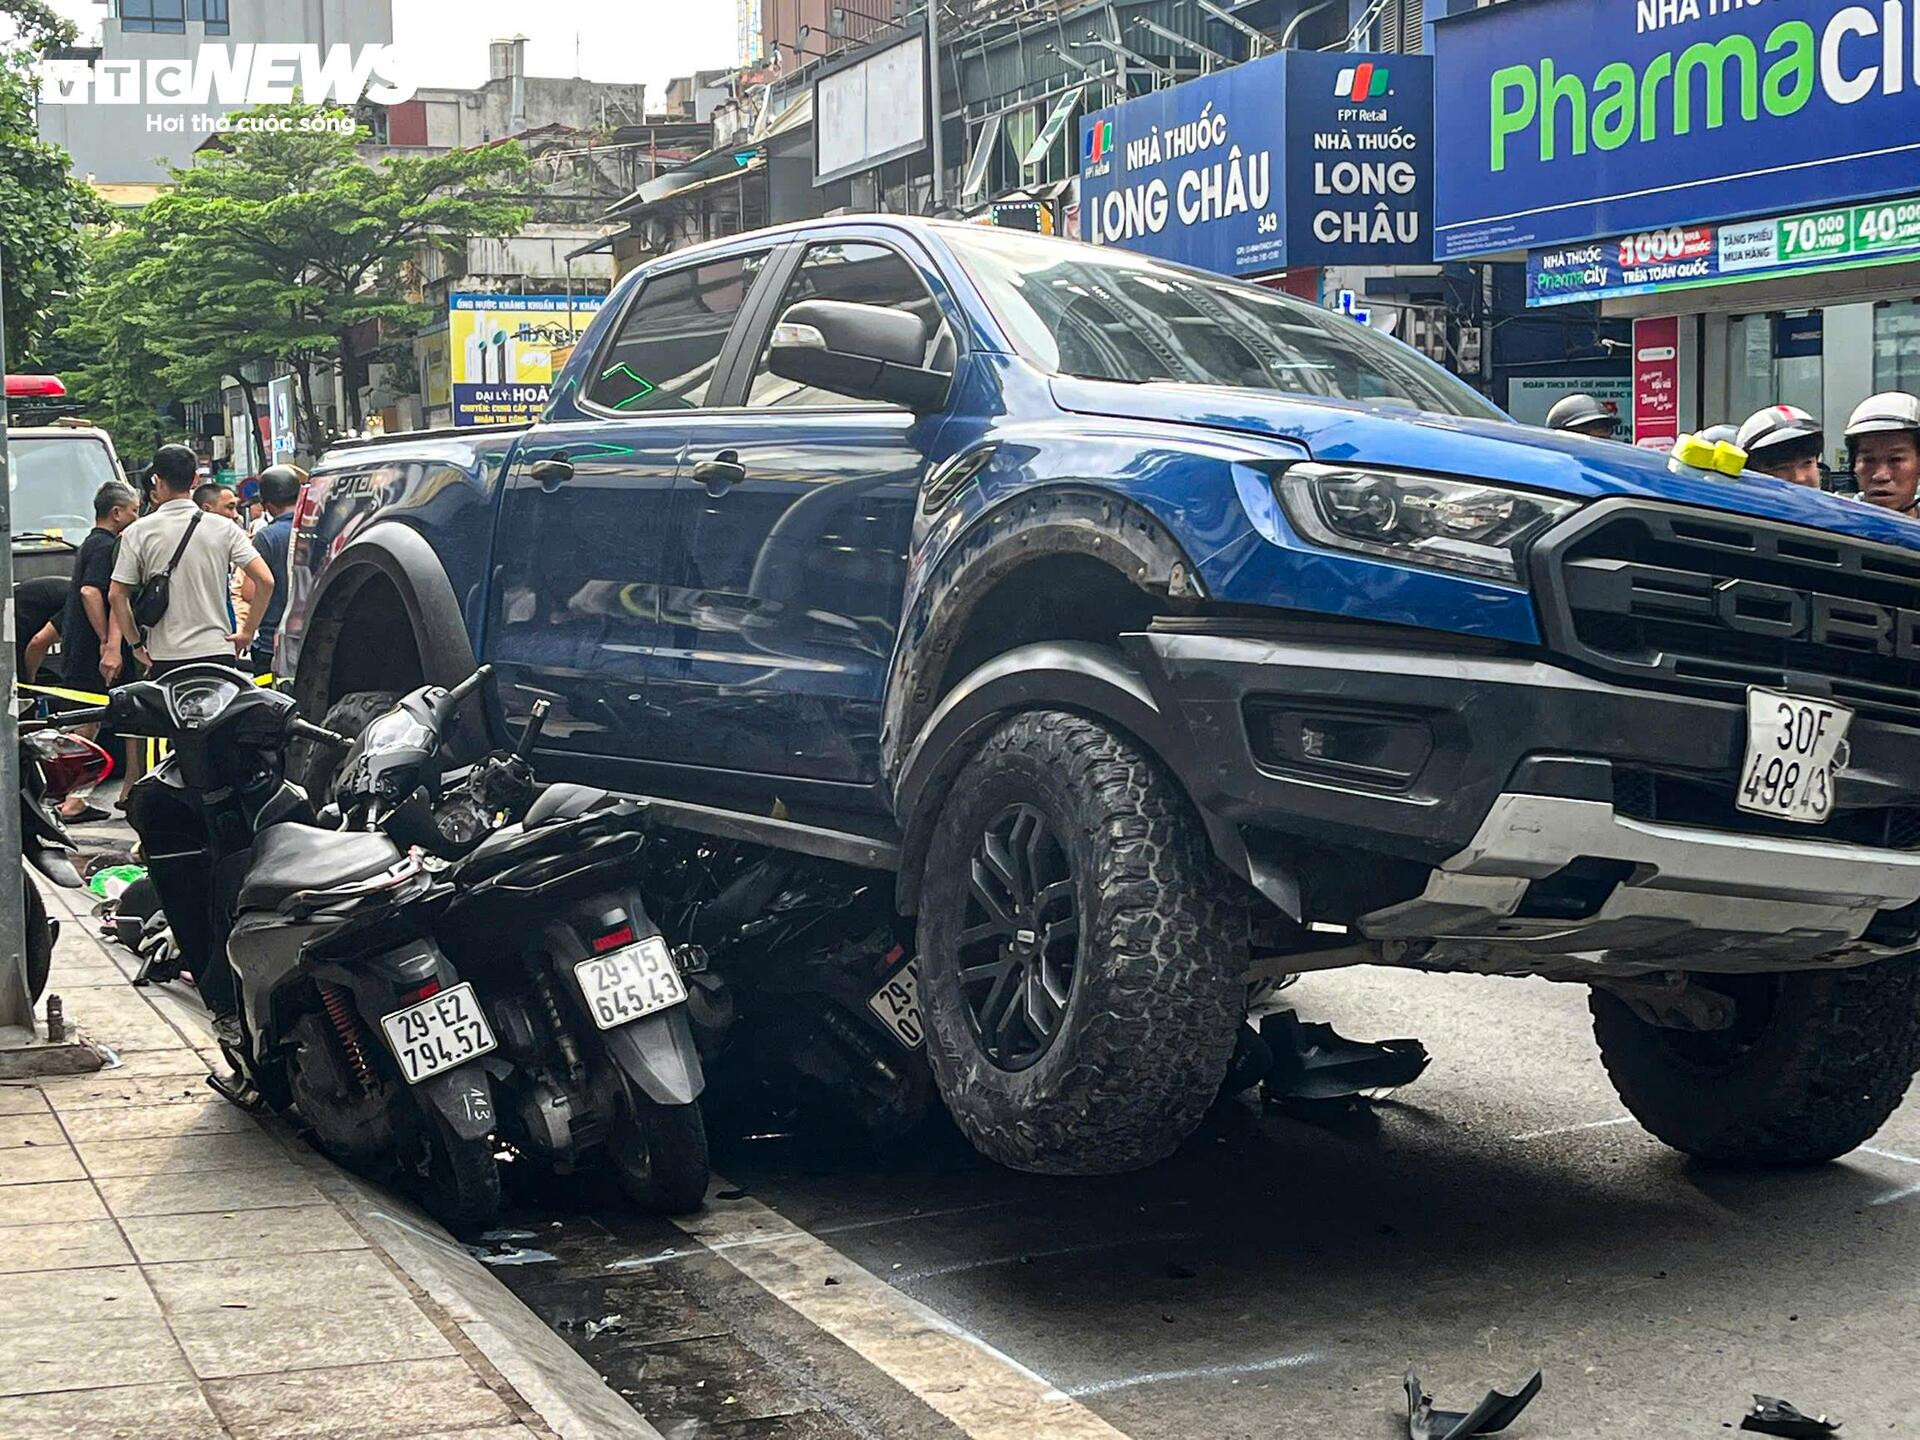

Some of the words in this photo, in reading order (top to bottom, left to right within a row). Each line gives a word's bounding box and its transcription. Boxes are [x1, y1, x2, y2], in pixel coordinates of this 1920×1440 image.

[1338, 109, 1358, 121] FPT
[1359, 109, 1387, 121] Retail
[1126, 125, 1161, 171] NHÀ
[1164, 101, 1228, 160] THUỐC
[1314, 129, 1353, 149] NHÀ
[1356, 125, 1416, 149] THUỐC
[1091, 178, 1169, 244] LONG
[1177, 144, 1270, 225] CHÂU
[1314, 161, 1416, 195] LONG
[1257, 212, 1278, 234] 343
[1313, 201, 1419, 243] CHÂU
[1723, 233, 1747, 250] TẶNG
[1748, 227, 1773, 244] PHIẾU
[1783, 218, 1818, 253] 70
[1817, 215, 1845, 234] 000
[1858, 207, 1896, 241] 40
[1543, 251, 1566, 270] NHÀ
[1566, 245, 1602, 265] THUỐC
[1621, 226, 1685, 266] 1000
[1723, 249, 1743, 263] MUA
[1744, 246, 1771, 259] HÀNG
[1538, 264, 1608, 290] Pharmacity
[1622, 266, 1648, 285] TRÊN
[1648, 263, 1676, 282] TOÀN
[1676, 258, 1710, 277] QUỐC
[457, 298, 474, 310] ỐNG
[475, 298, 498, 310] NƯỚC
[499, 299, 526, 310] KHÁNG
[476, 390, 494, 404] ĐẠI
[1777, 702, 1833, 758] 30F
[1744, 753, 1828, 814] 498.43
[590, 946, 659, 991] 29-Y5
[595, 972, 679, 1022] 645.43
[398, 994, 469, 1044] 29-E2
[402, 1021, 489, 1077] 794.52
